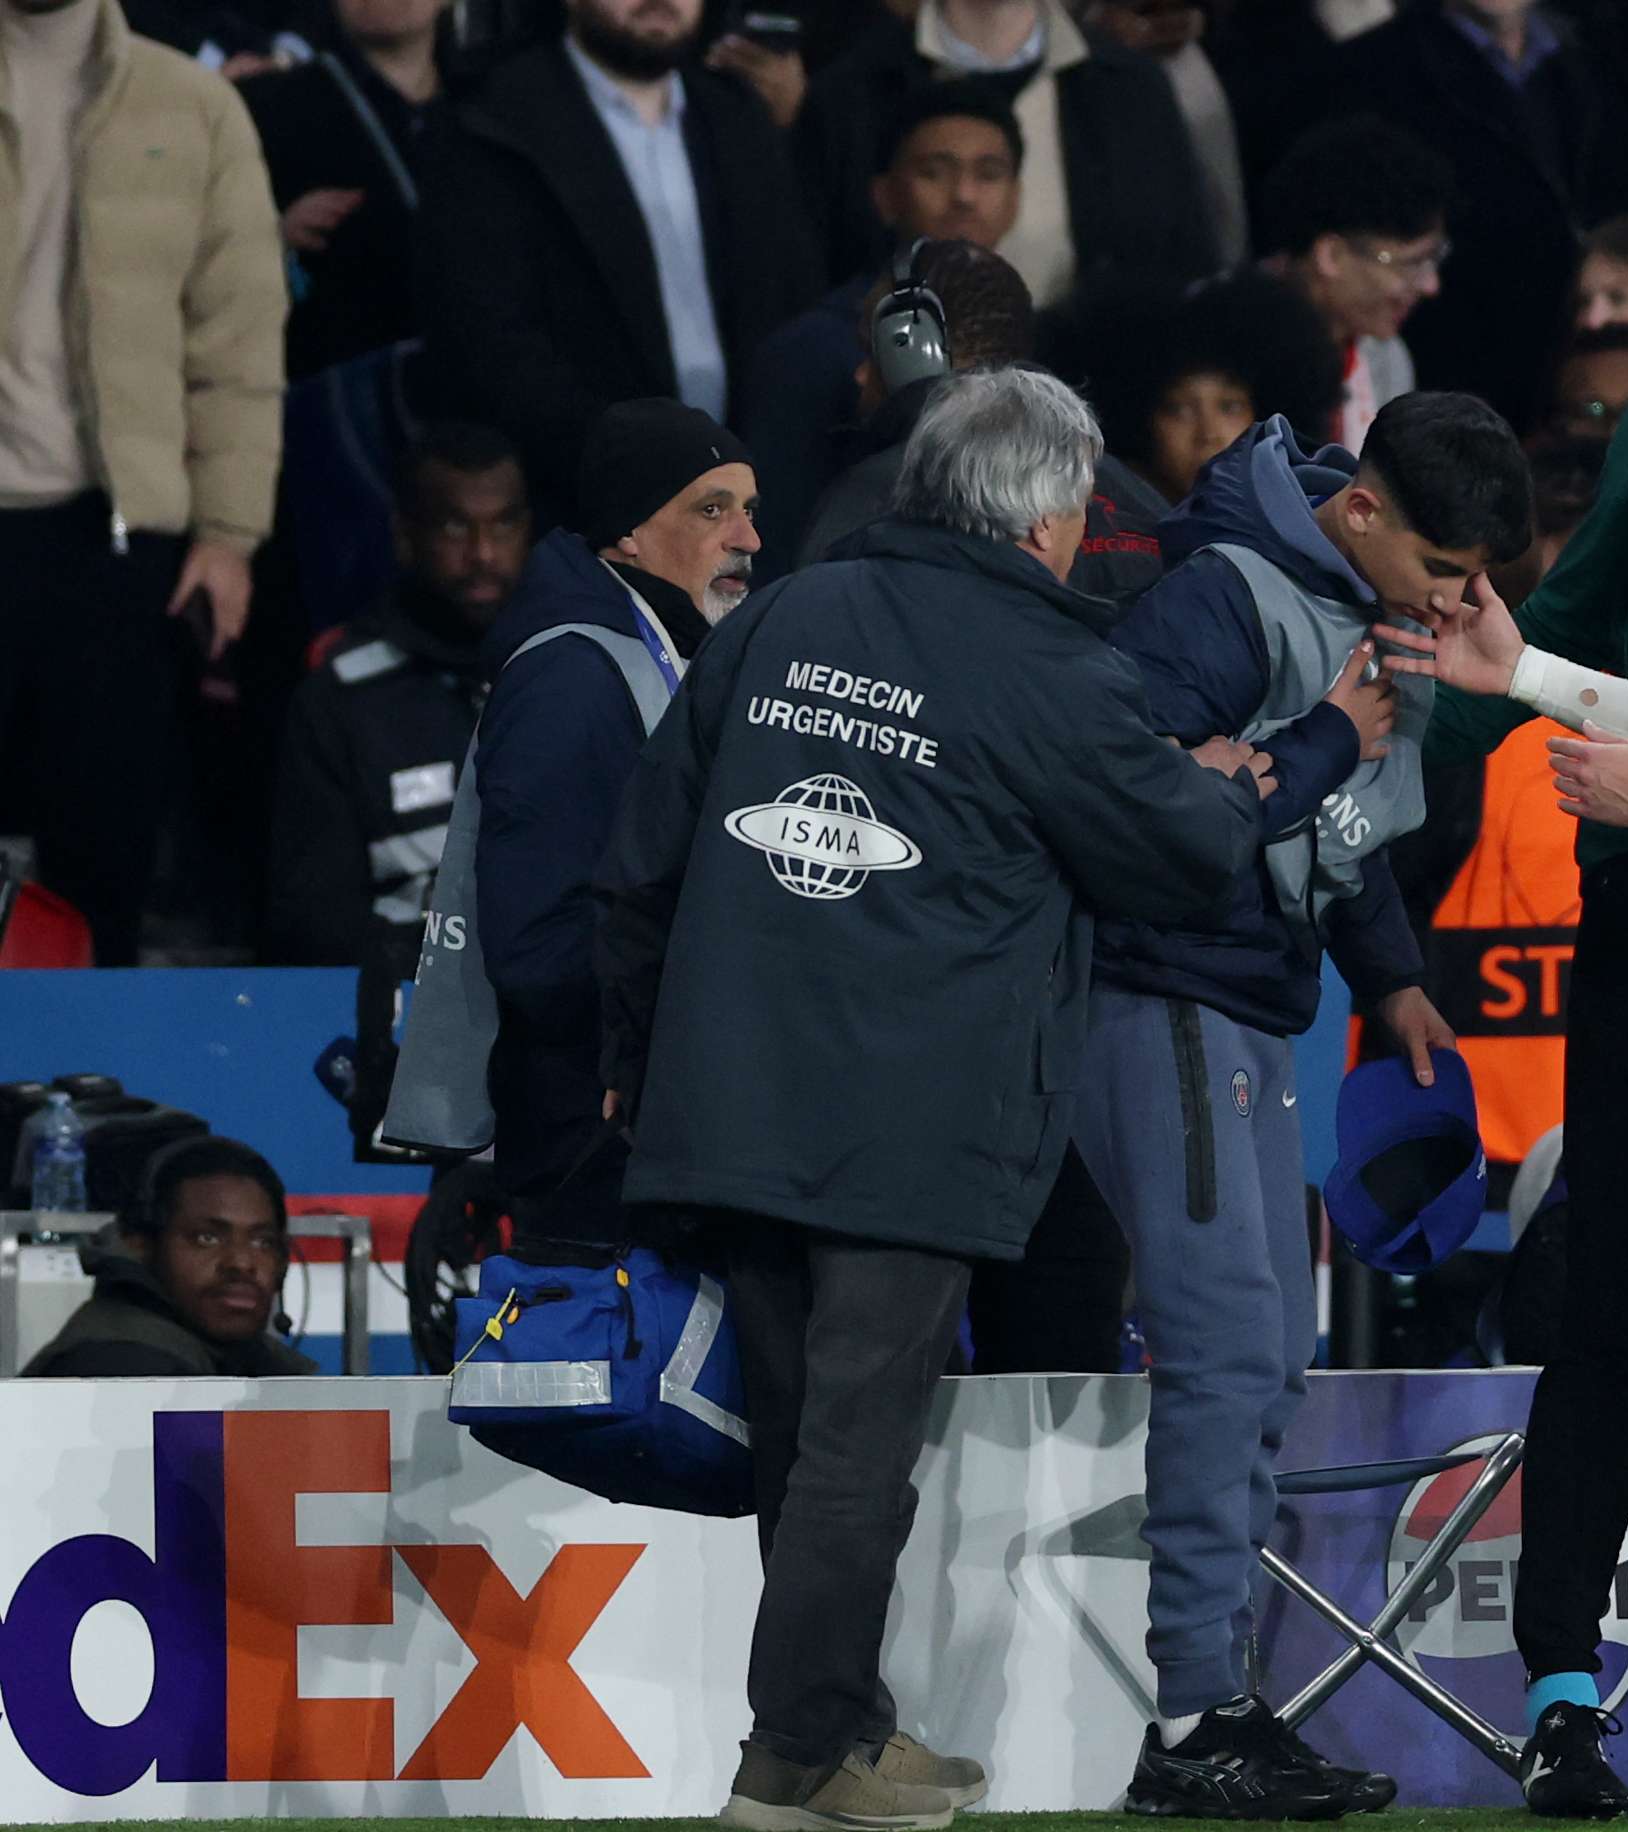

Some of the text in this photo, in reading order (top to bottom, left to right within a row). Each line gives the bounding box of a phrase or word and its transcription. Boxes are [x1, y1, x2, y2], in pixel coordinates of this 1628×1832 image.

[785, 661, 924, 719] MEDECIN
[748, 697, 939, 768] URGENTISTE
[780, 816, 861, 856] ISMA
[0, 1410, 652, 1796] dEx
